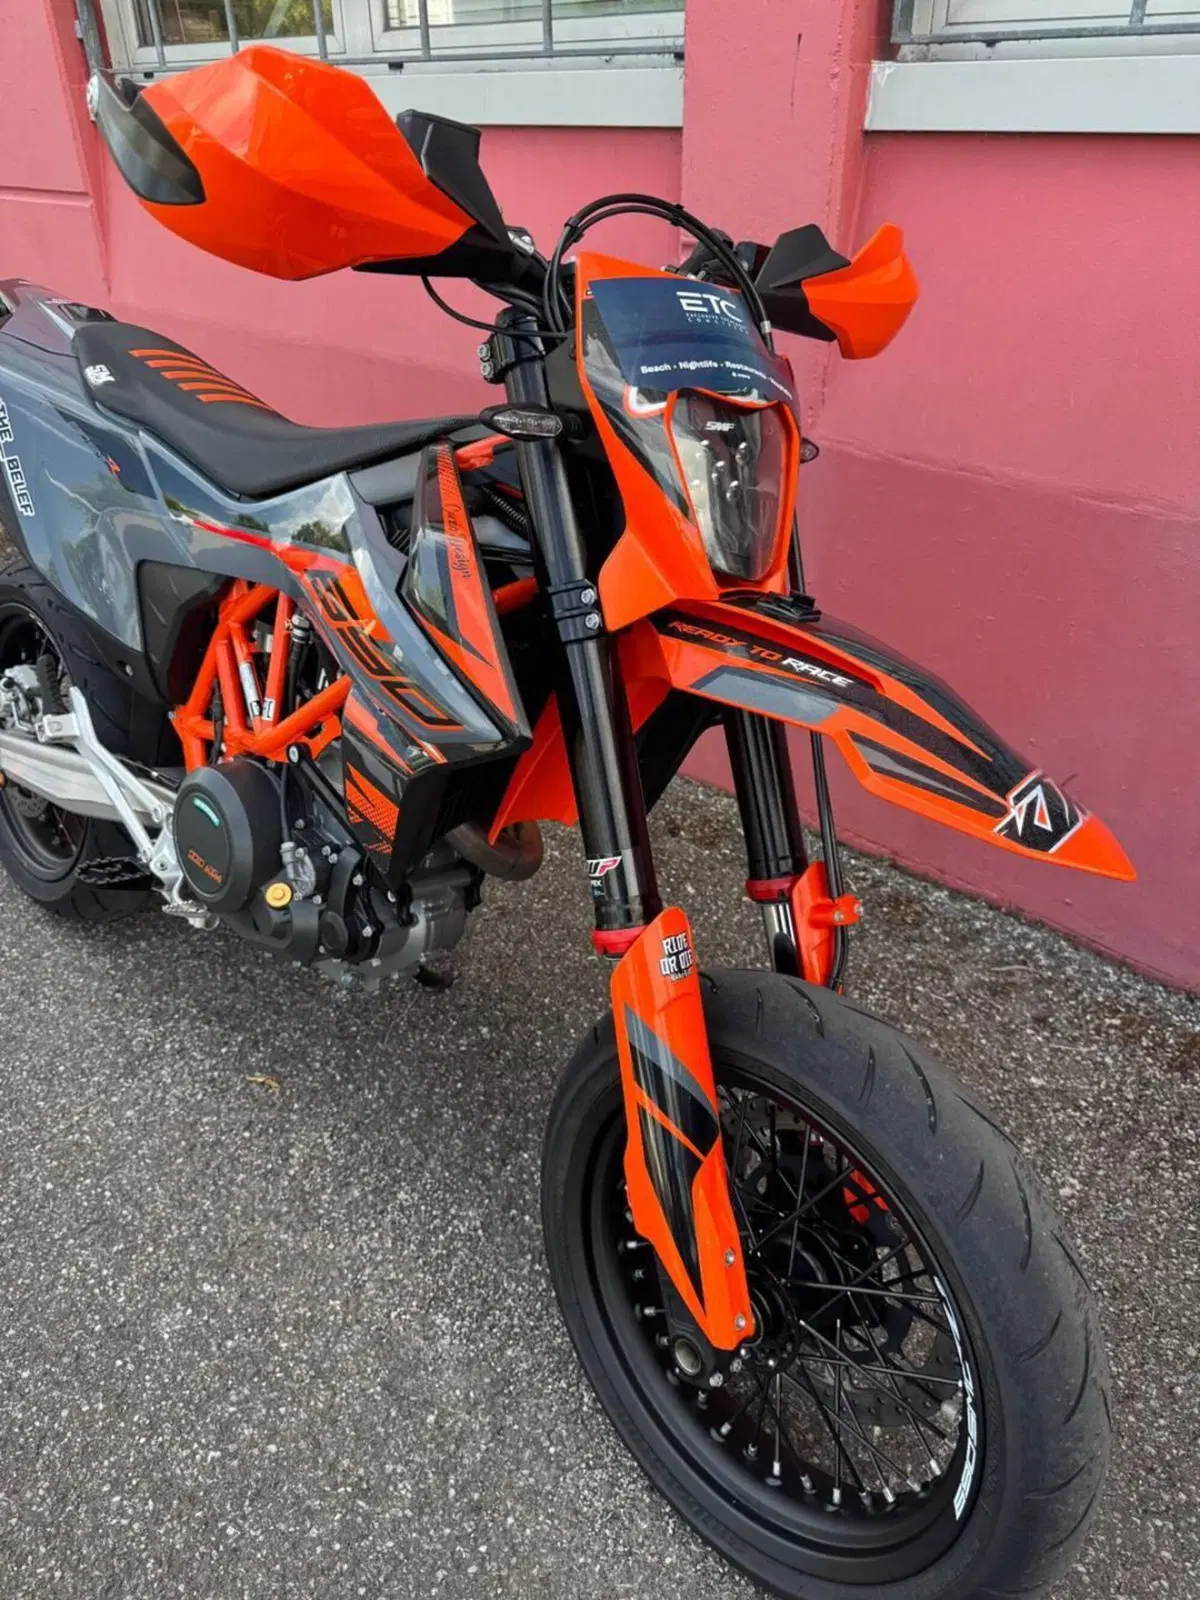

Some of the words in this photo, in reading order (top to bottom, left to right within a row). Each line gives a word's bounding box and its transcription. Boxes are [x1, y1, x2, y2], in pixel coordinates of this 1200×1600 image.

[676, 291, 743, 323] ETC
[640, 362, 671, 374] Beach
[678, 360, 718, 372] Nightlife
[668, 621, 748, 646] READY
[750, 645, 783, 661] TO
[780, 657, 855, 688] RACE
[662, 932, 688, 955] RIDE
[659, 955, 678, 976] OR
